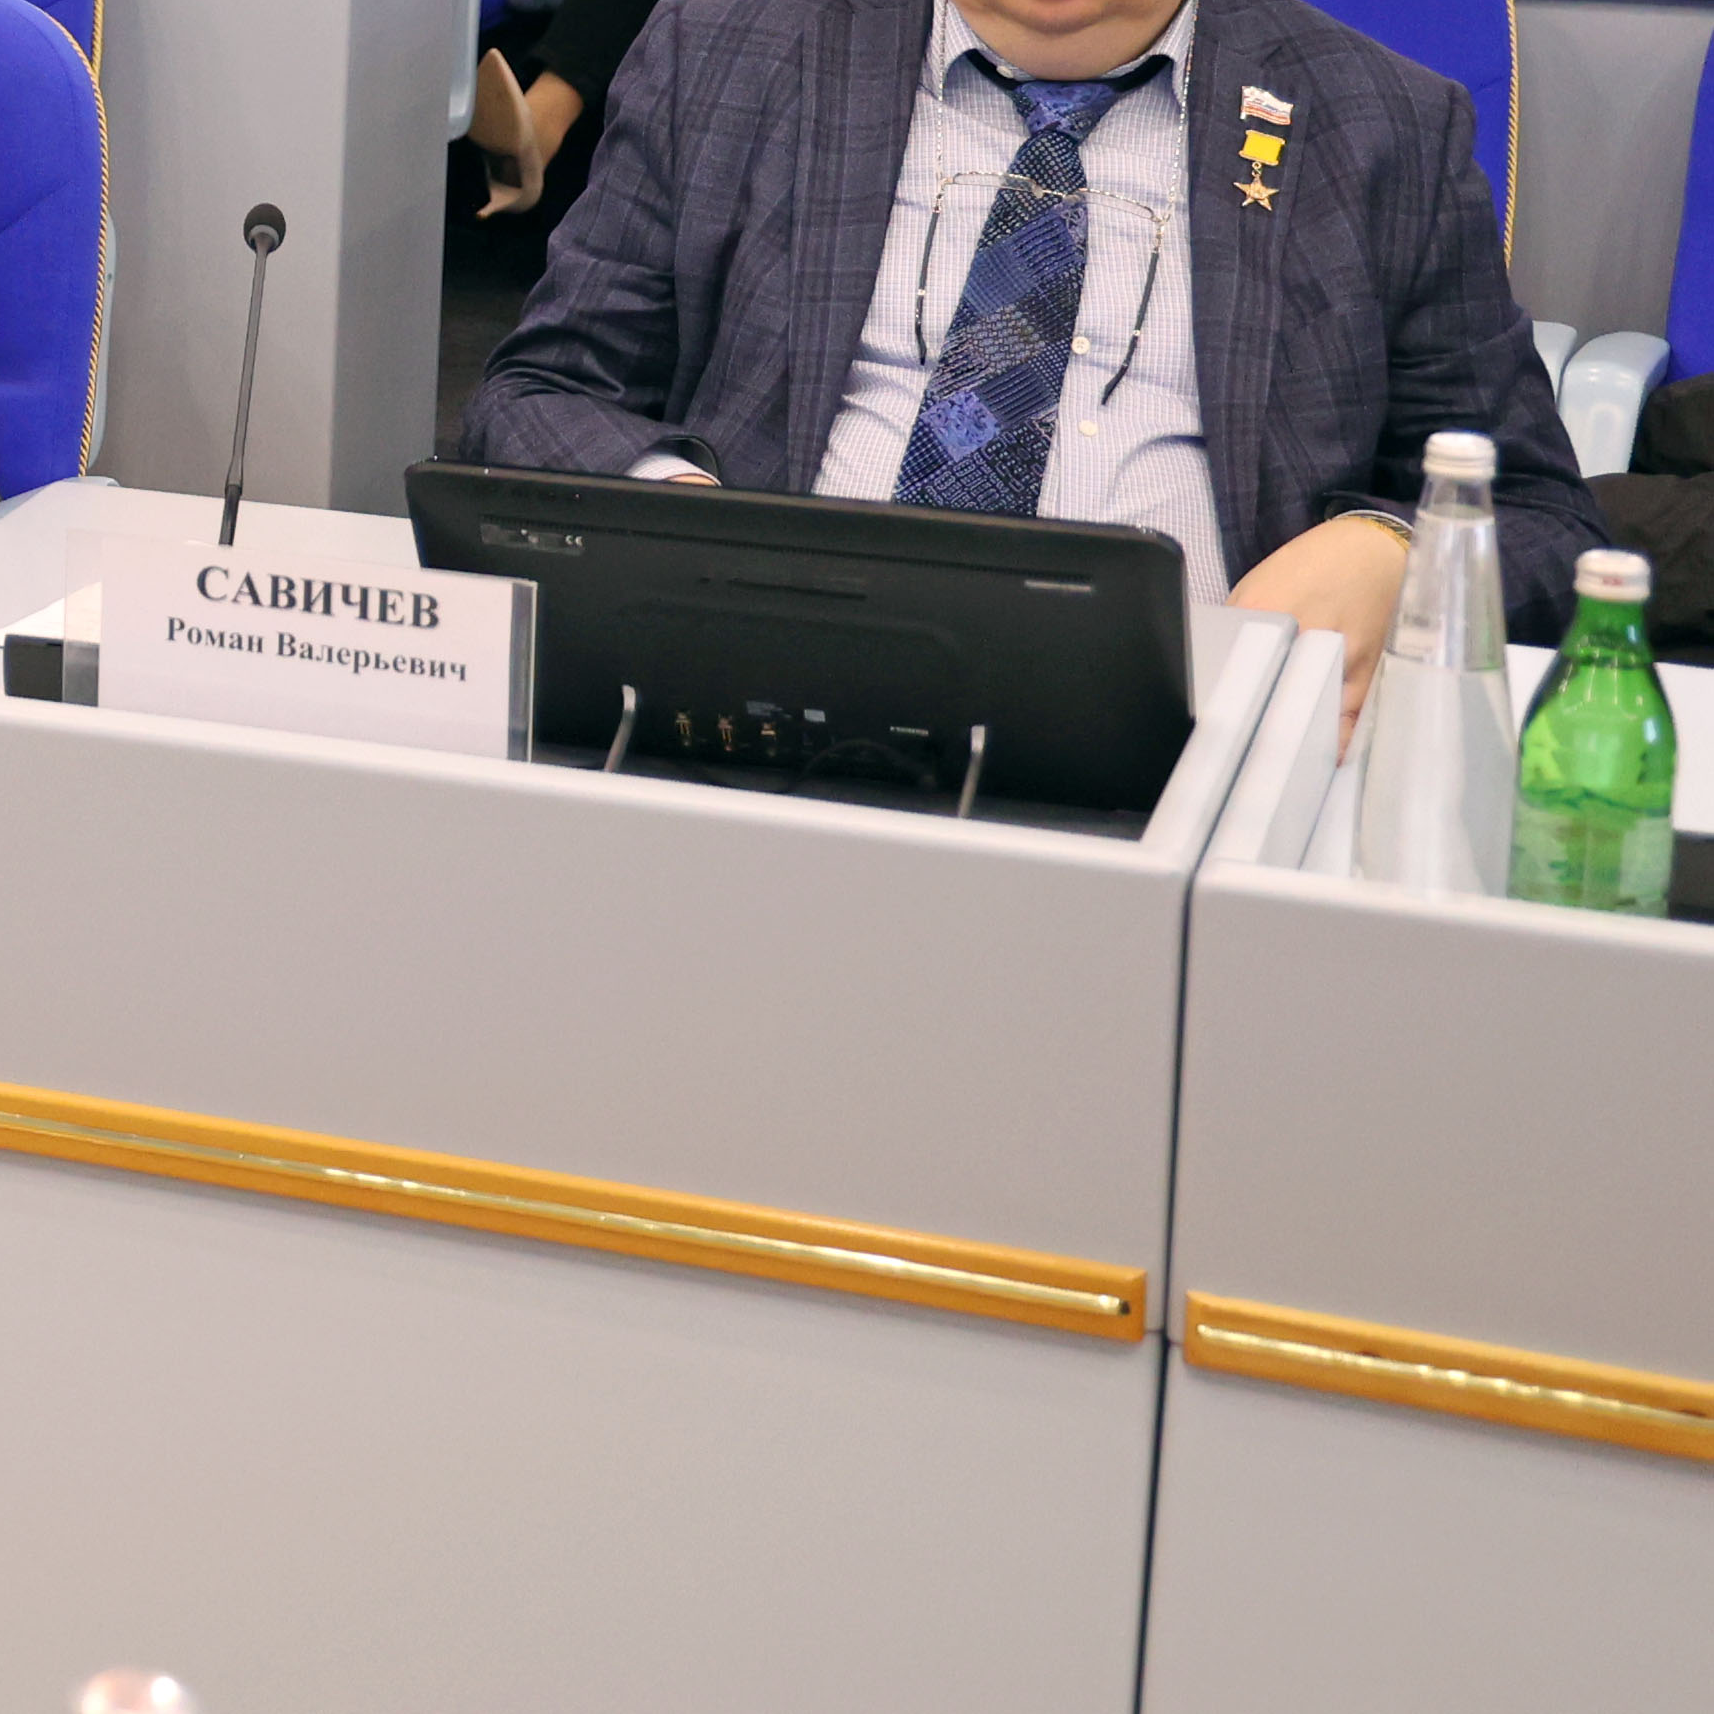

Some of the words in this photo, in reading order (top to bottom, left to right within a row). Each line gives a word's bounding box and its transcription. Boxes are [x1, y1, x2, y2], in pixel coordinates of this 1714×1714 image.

[196, 565, 441, 630] САВИЧЕВ
[166, 616, 264, 655] Роман
[276, 632, 467, 682] Валерьевич
